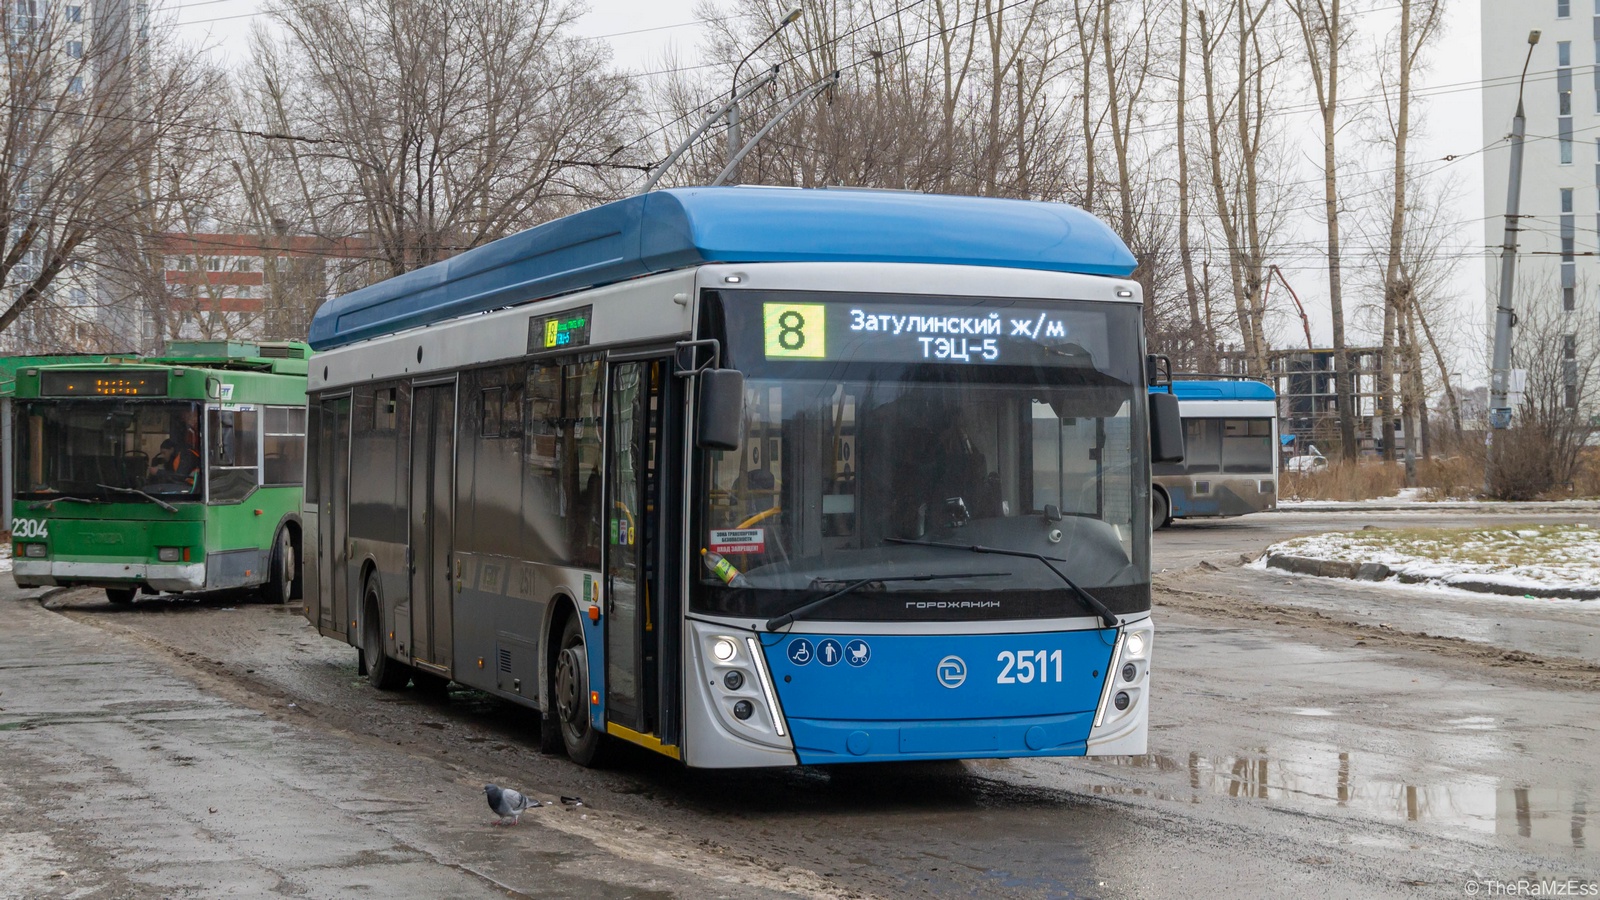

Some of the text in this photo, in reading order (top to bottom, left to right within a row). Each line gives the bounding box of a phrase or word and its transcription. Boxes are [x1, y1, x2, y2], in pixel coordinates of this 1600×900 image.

[778, 310, 805, 351] 8
[850, 309, 1065, 338] Затулинский ж/м
[918, 336, 998, 361] ТЭЦ-5
[12, 518, 48, 538] 2304
[906, 601, 1000, 609] ГОРОЖАНИН
[997, 649, 1062, 684] 2511
